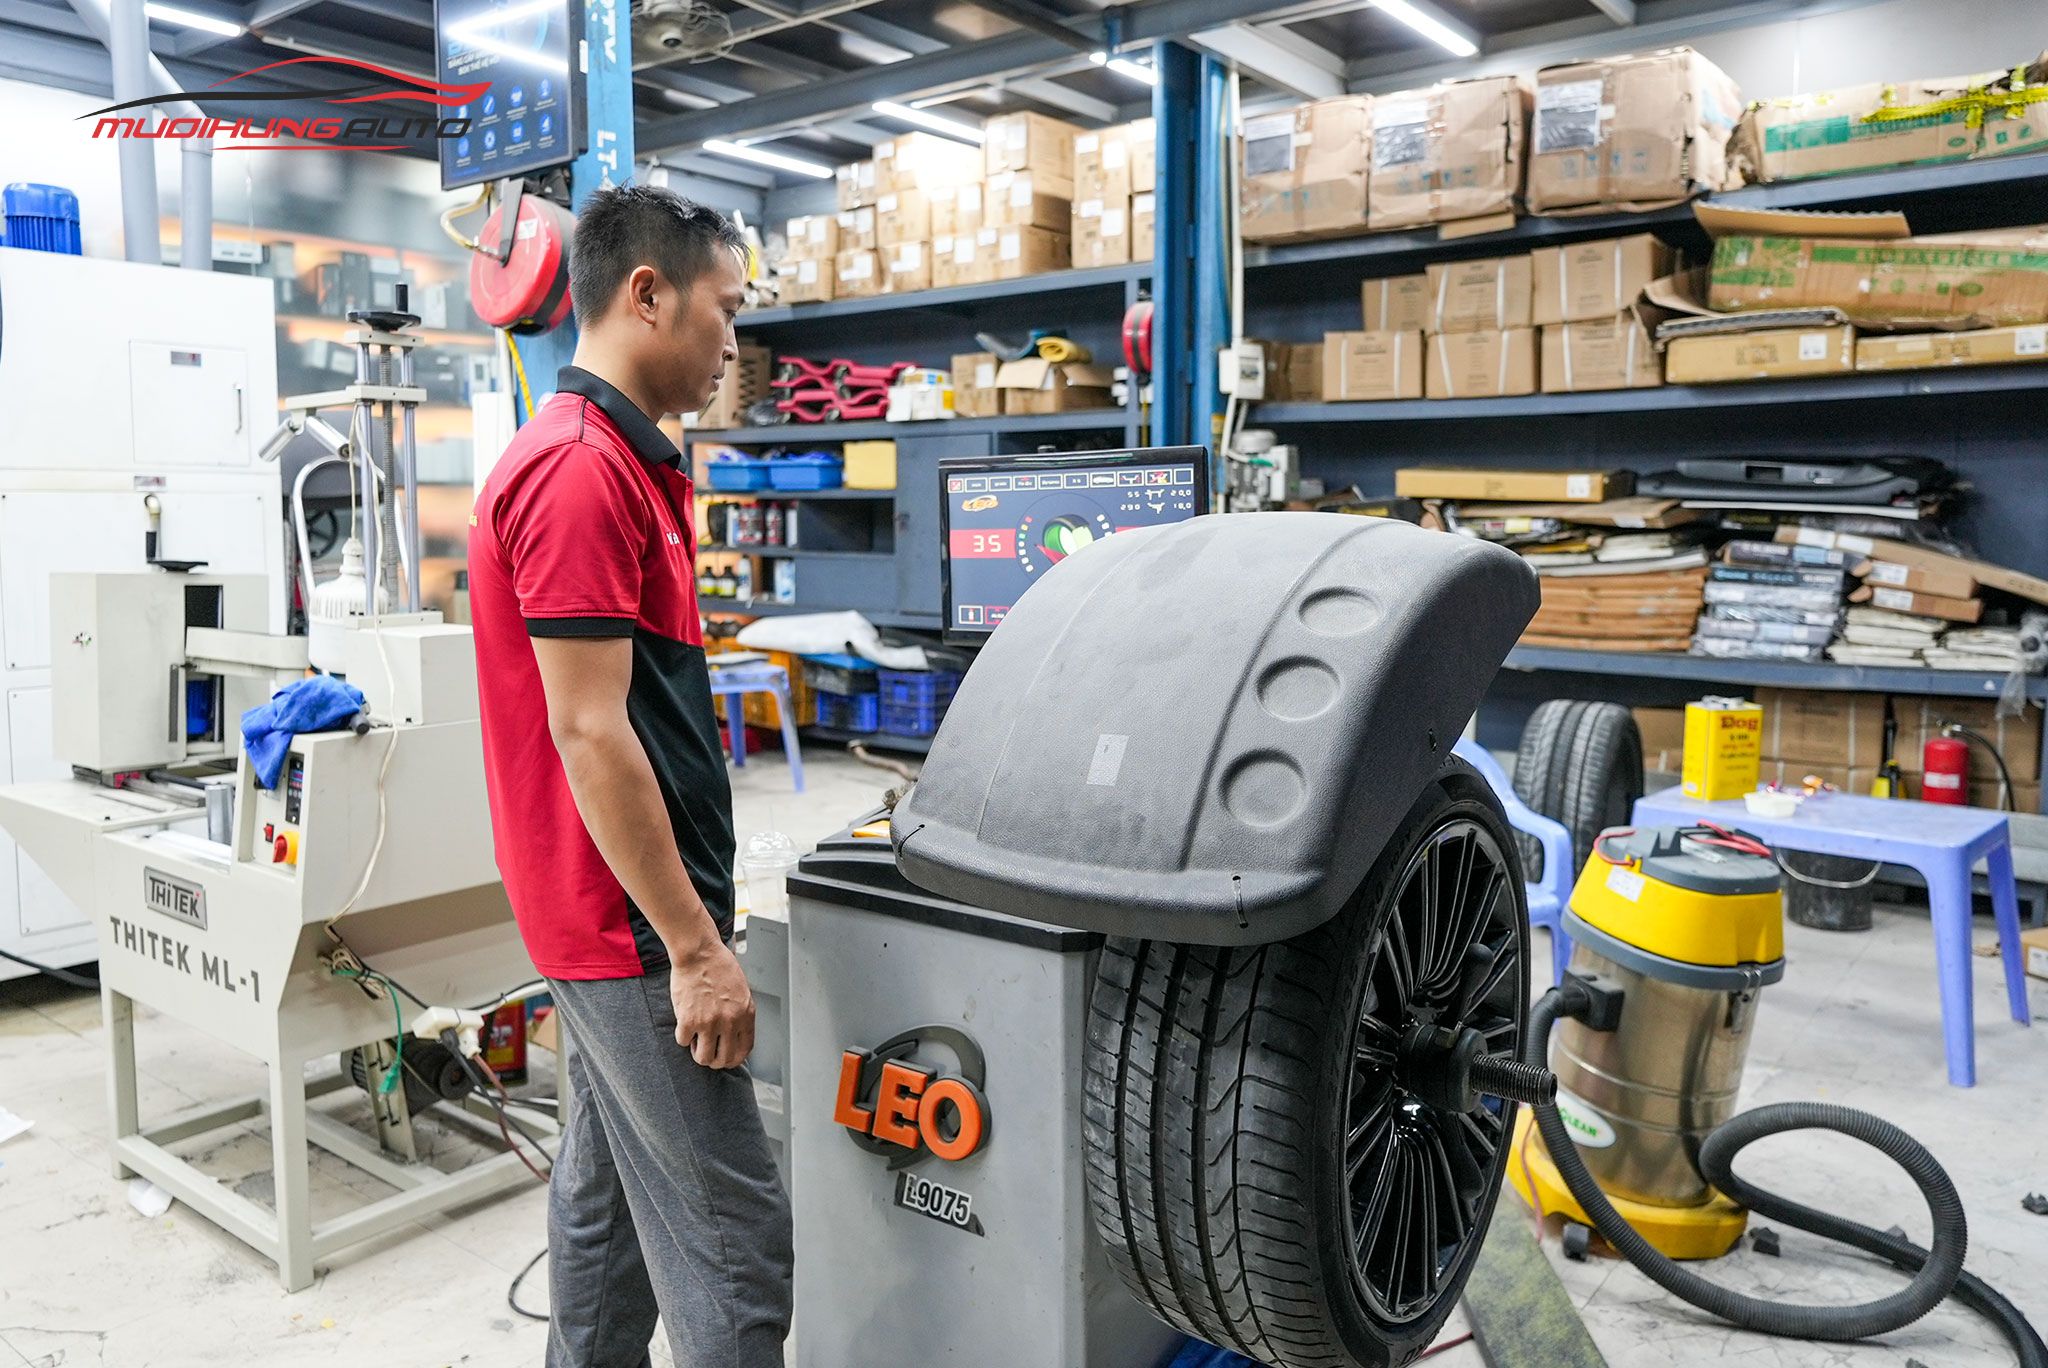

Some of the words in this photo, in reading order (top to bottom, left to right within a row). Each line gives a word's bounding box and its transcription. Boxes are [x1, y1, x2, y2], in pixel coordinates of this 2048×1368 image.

[973, 534, 1002, 553] 35
[110, 916, 191, 974] THITEK
[201, 951, 260, 1003] ML-1
[833, 1051, 985, 1161] LEO
